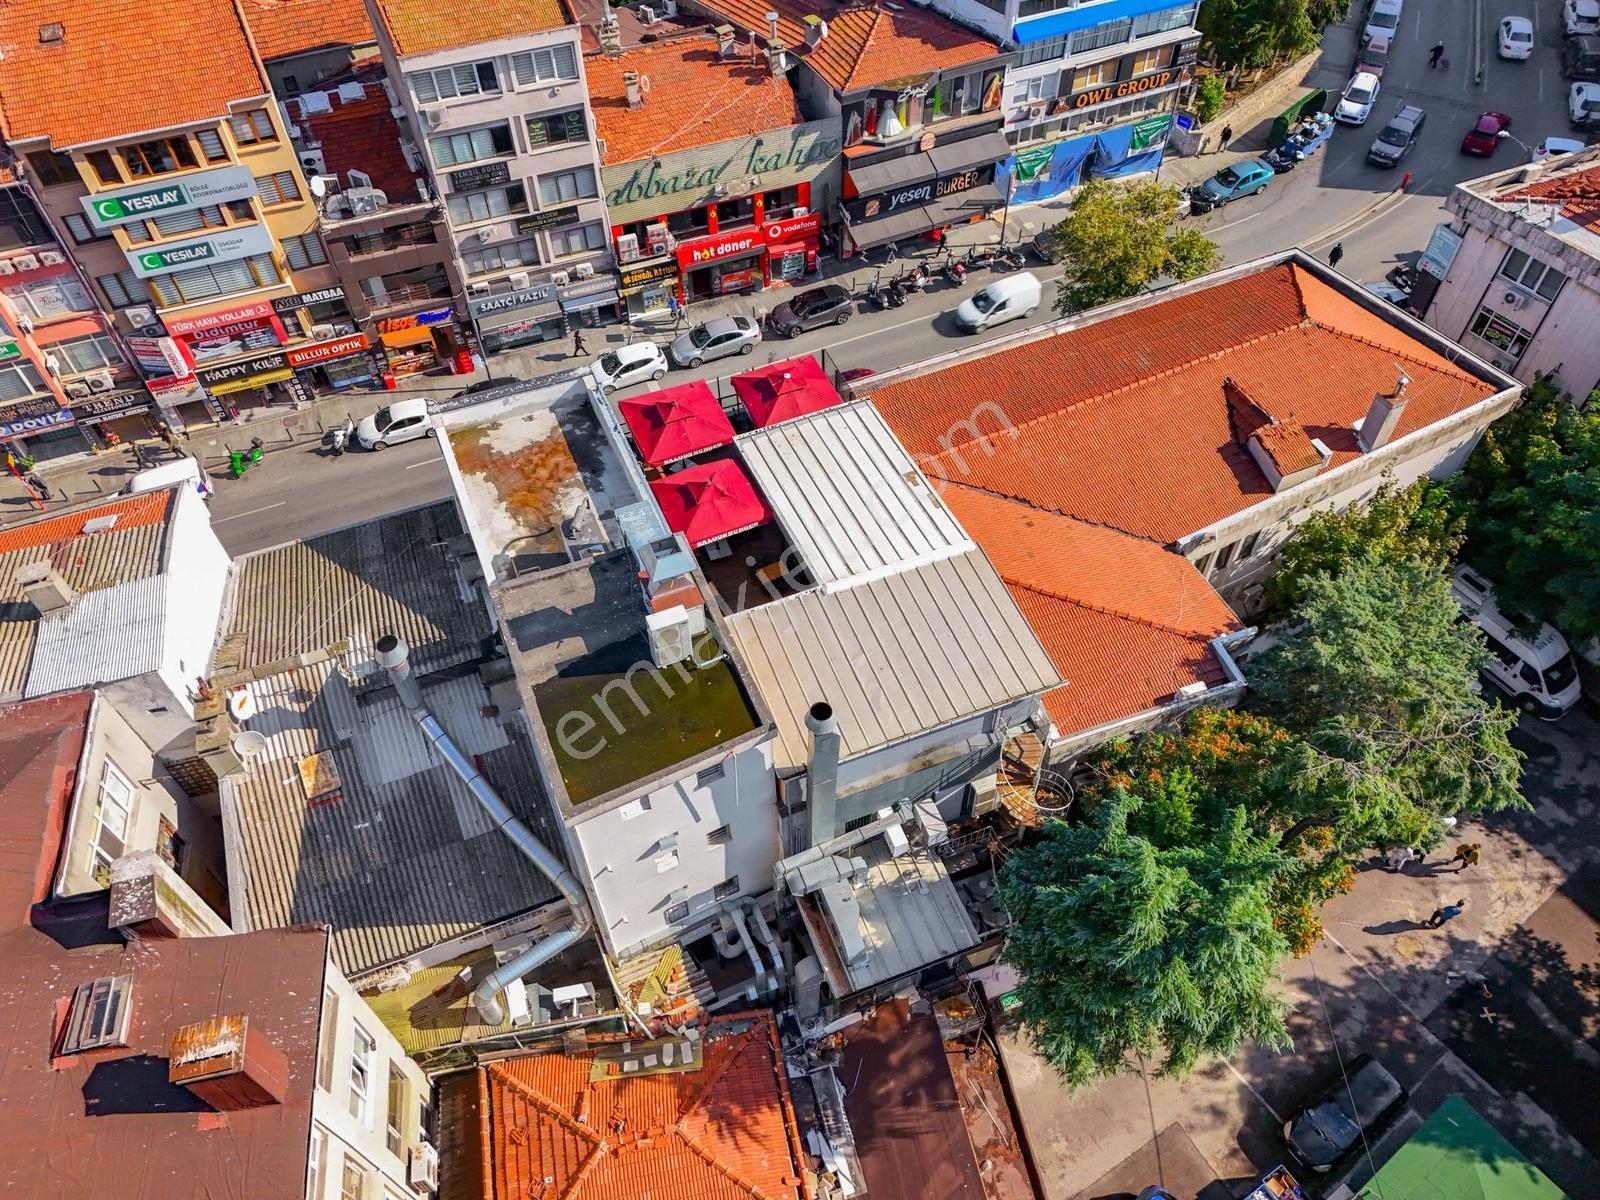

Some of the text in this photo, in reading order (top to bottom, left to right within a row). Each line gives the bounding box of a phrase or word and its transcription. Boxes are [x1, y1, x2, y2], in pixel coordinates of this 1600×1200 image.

[1075, 72, 1171, 109] OWL GROUP
[122, 189, 179, 212] YEŞİLAY
[888, 171, 979, 210] yesen BURGER
[783, 219, 817, 233] vodafone
[162, 245, 208, 264] YEŞİLAY
[302, 287, 345, 304] MATBAA
[171, 309, 255, 333] TÜRK HAVA YOLLARI
[294, 338, 363, 363] BİLLUR OPTİK
[205, 365, 247, 382] HAPPY
[82, 395, 135, 412] TREND
[10, 411, 66, 433] DÖVİZ
